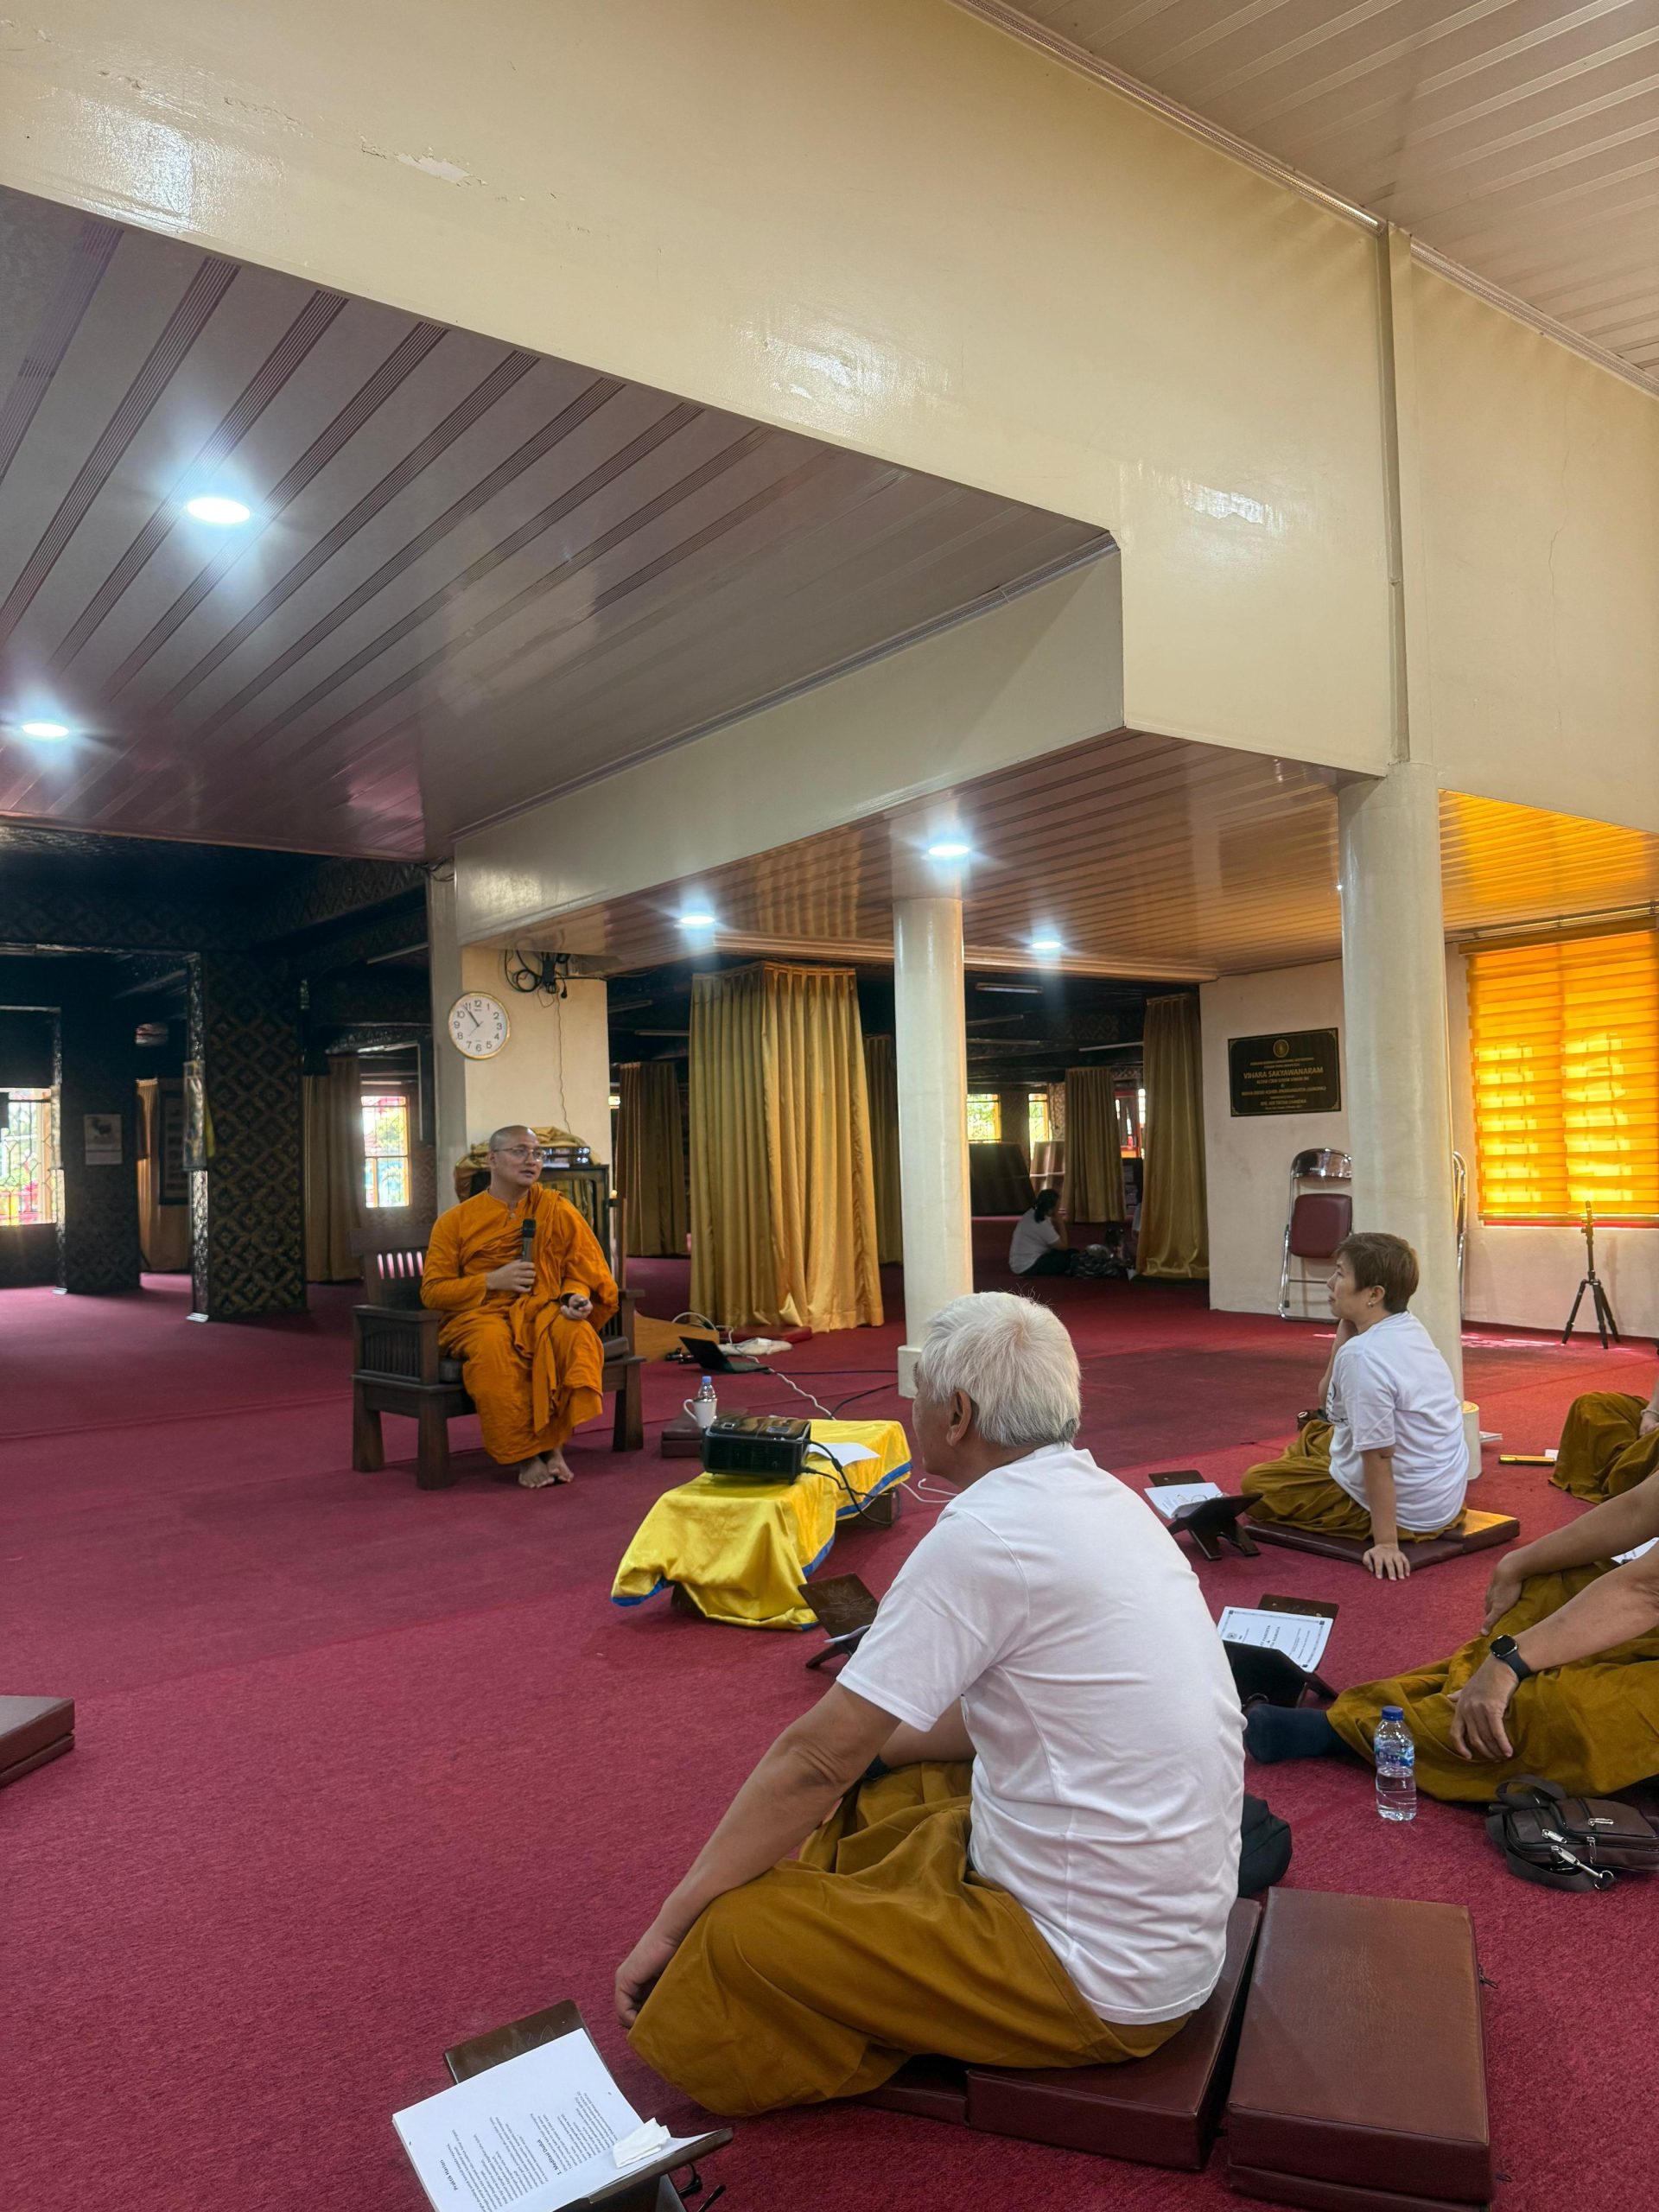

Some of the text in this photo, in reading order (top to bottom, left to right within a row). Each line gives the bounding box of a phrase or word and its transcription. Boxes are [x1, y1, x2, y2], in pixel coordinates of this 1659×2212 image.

[1243, 1071, 1268, 1079] VIHARA
[536, 2138, 548, 2153] Duduk
[544, 2151, 559, 2171] Meditasi
[438, 2158, 459, 2191] Praktik Harian
